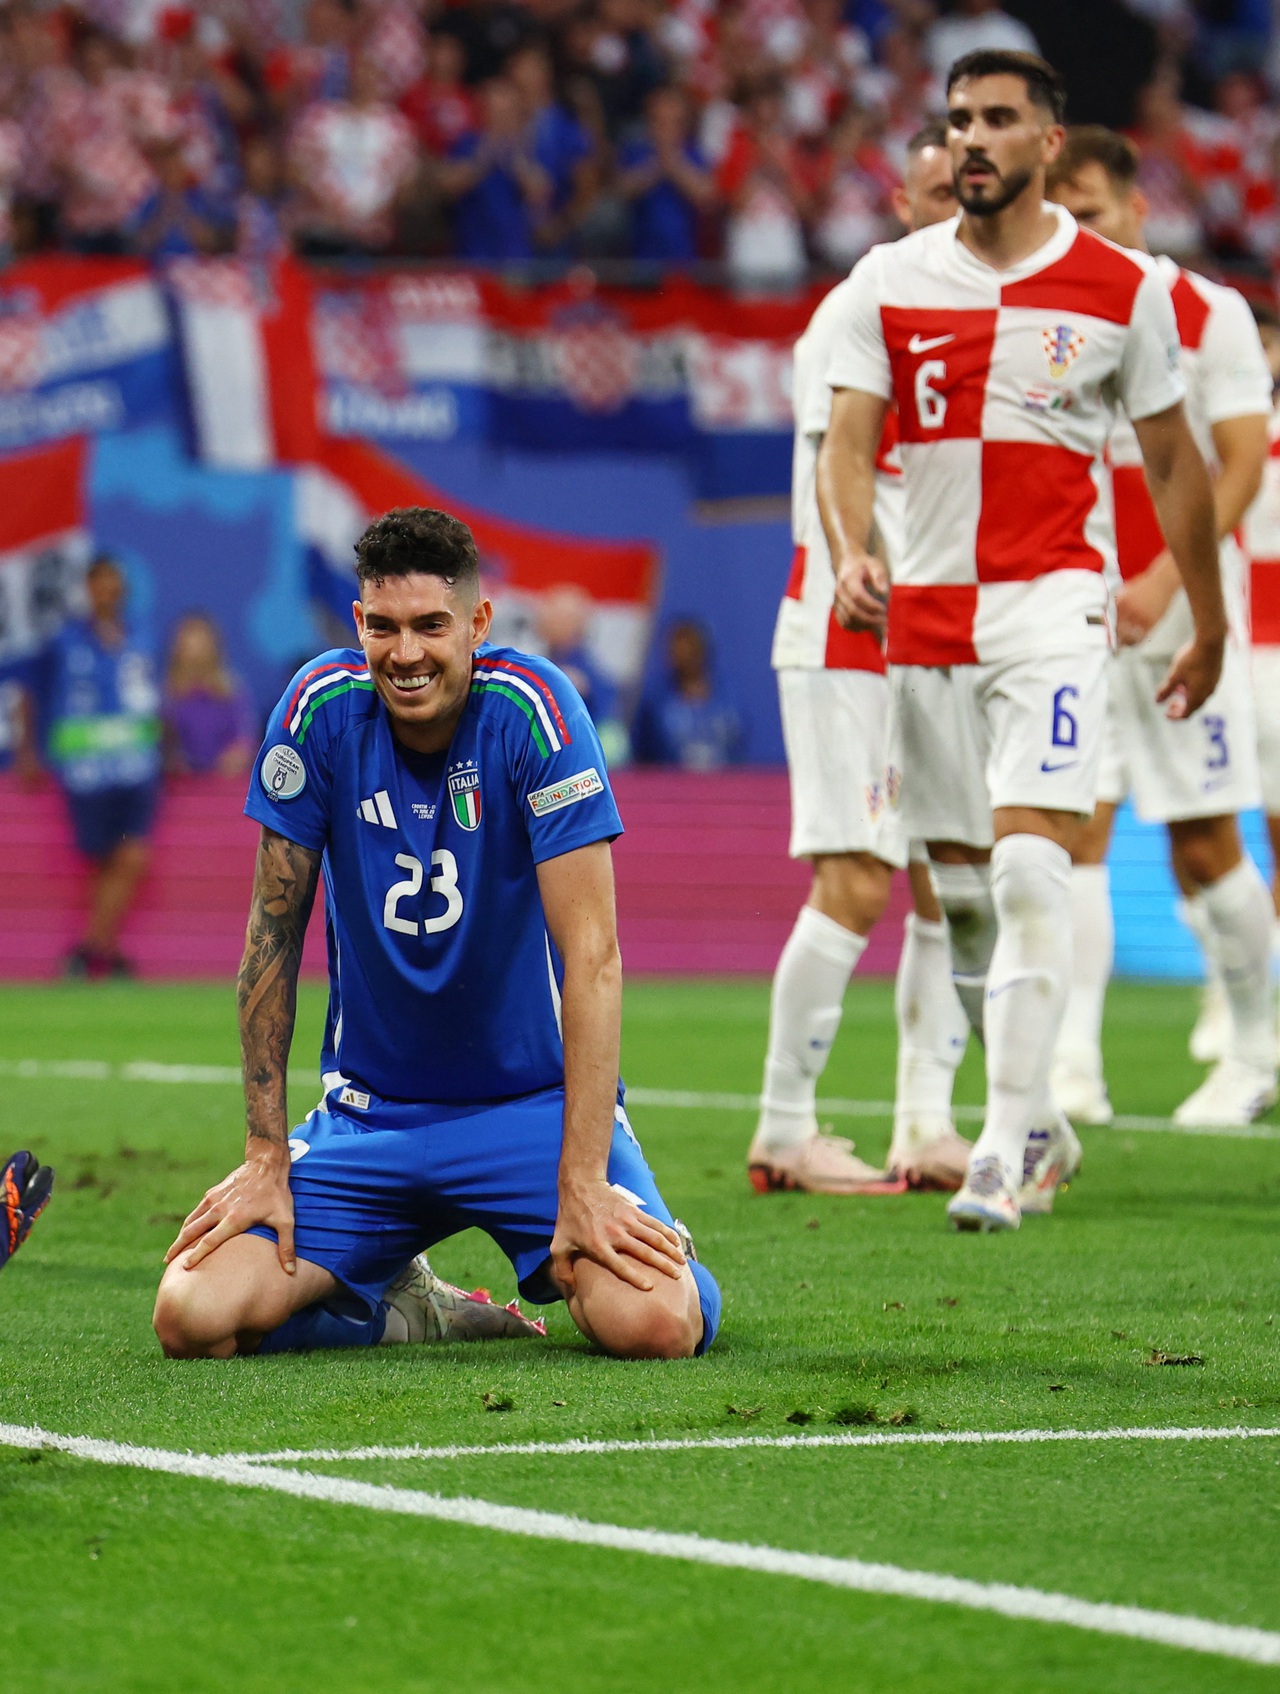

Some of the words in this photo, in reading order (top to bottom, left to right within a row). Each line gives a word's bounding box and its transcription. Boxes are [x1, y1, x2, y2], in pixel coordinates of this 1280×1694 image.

[915, 359, 948, 430] 6
[1051, 685, 1078, 747] 6
[275, 751, 300, 771] EUROPEAN
[1202, 716, 1228, 770] 3
[272, 756, 298, 776] CHAMPIONS
[451, 773, 479, 791] ITALIA
[529, 791, 545, 801] UEFA
[383, 848, 464, 937] 23
